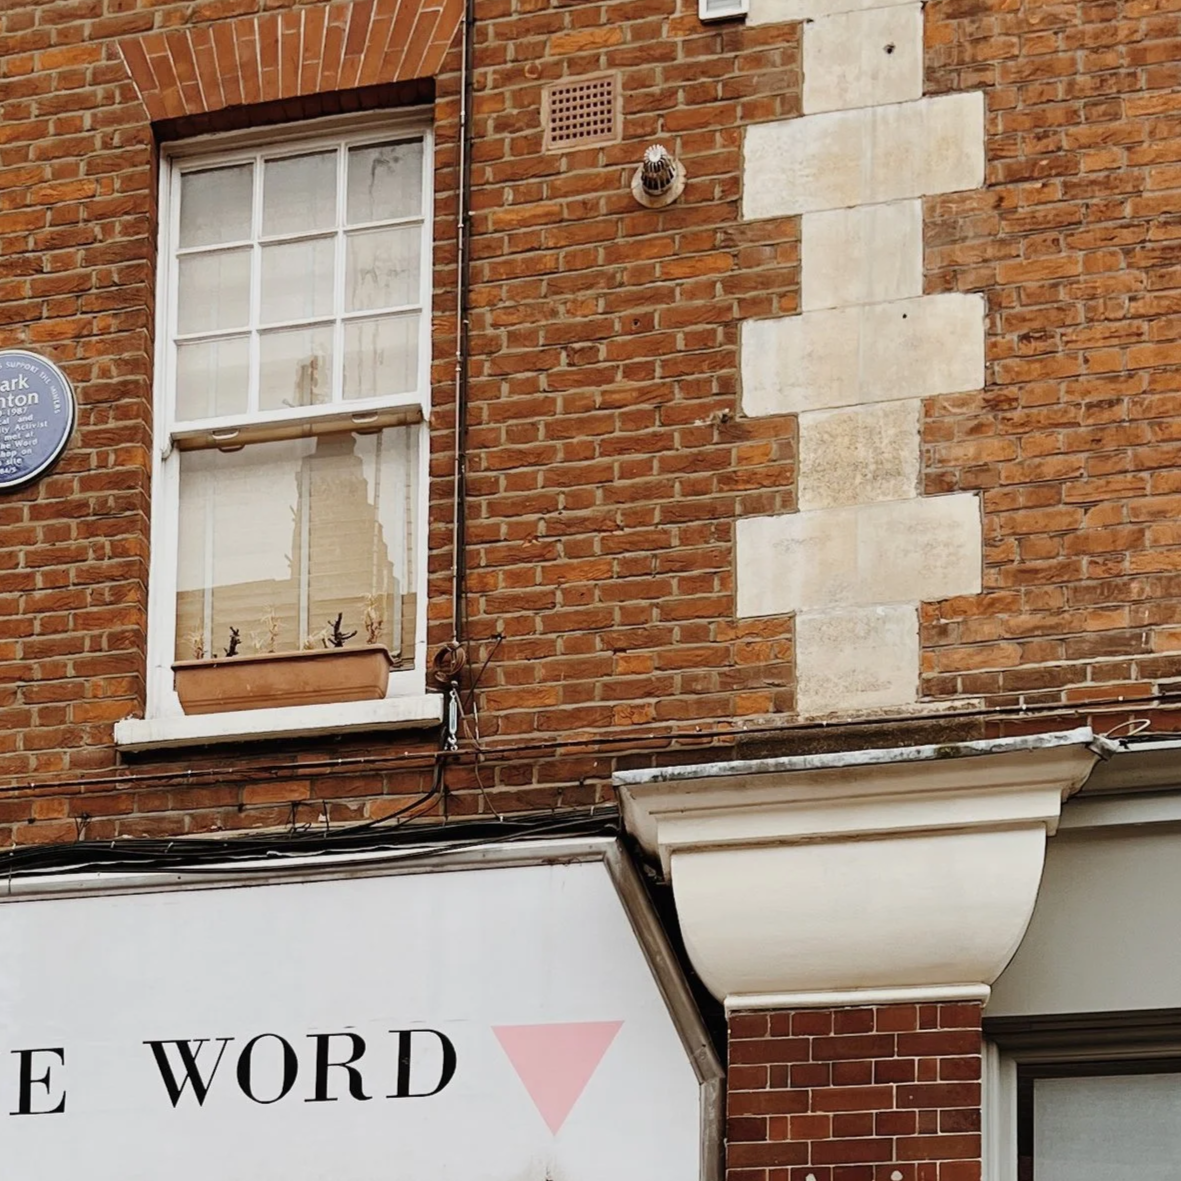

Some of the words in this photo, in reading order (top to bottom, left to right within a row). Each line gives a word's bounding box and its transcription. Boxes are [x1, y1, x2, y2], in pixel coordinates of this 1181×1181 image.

[6, 361, 39, 374] SUPPORT
[39, 371, 52, 385] THE
[50, 385, 61, 414] MINERS
[17, 414, 34, 423] and
[15, 420, 49, 431] Activist
[4, 432, 21, 441] met
[25, 431, 34, 439] at
[15, 438, 39, 448] Word
[6, 457, 23, 466] site
[142, 1028, 458, 1109] WORD
